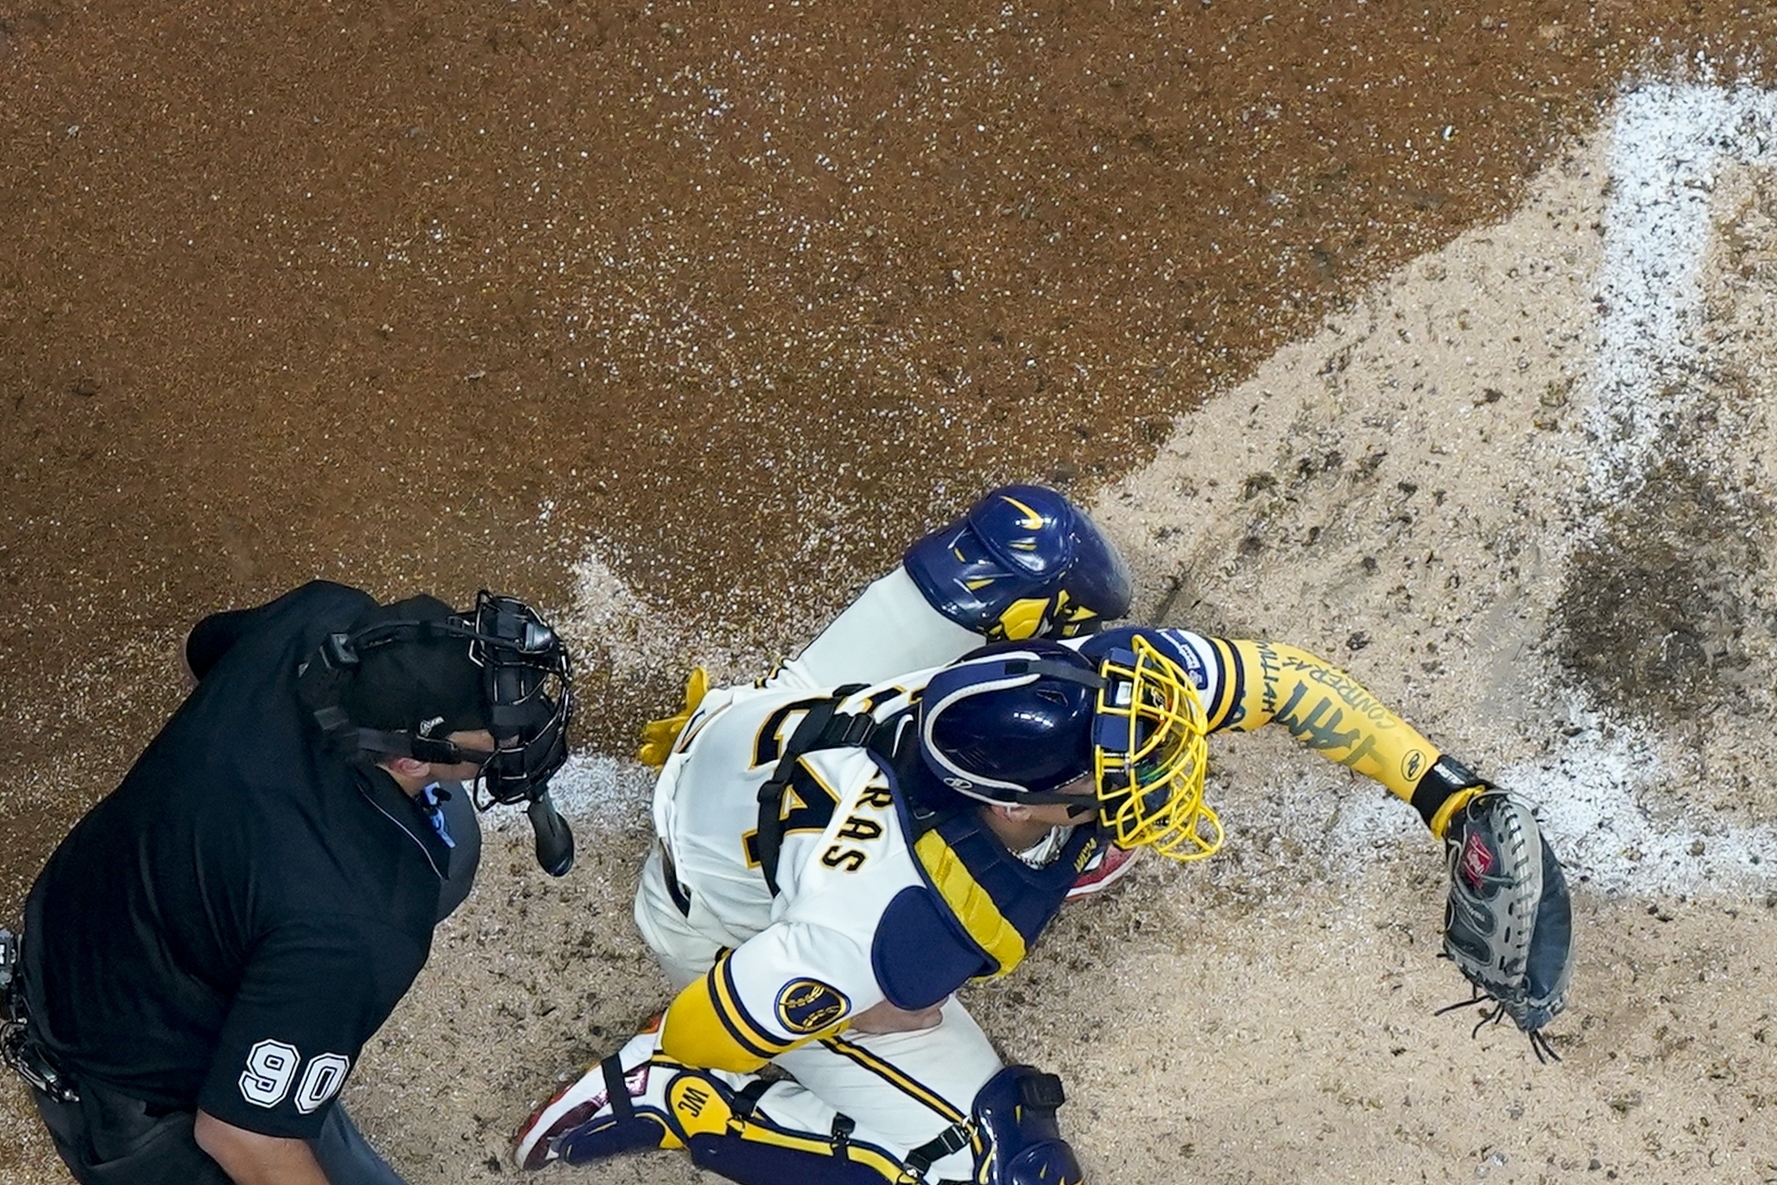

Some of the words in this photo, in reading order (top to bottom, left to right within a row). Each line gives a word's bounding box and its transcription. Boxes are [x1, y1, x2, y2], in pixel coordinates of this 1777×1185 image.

[821, 766, 892, 873] RAS
[238, 1038, 350, 1115] 90
[677, 1086, 710, 1119] WC
